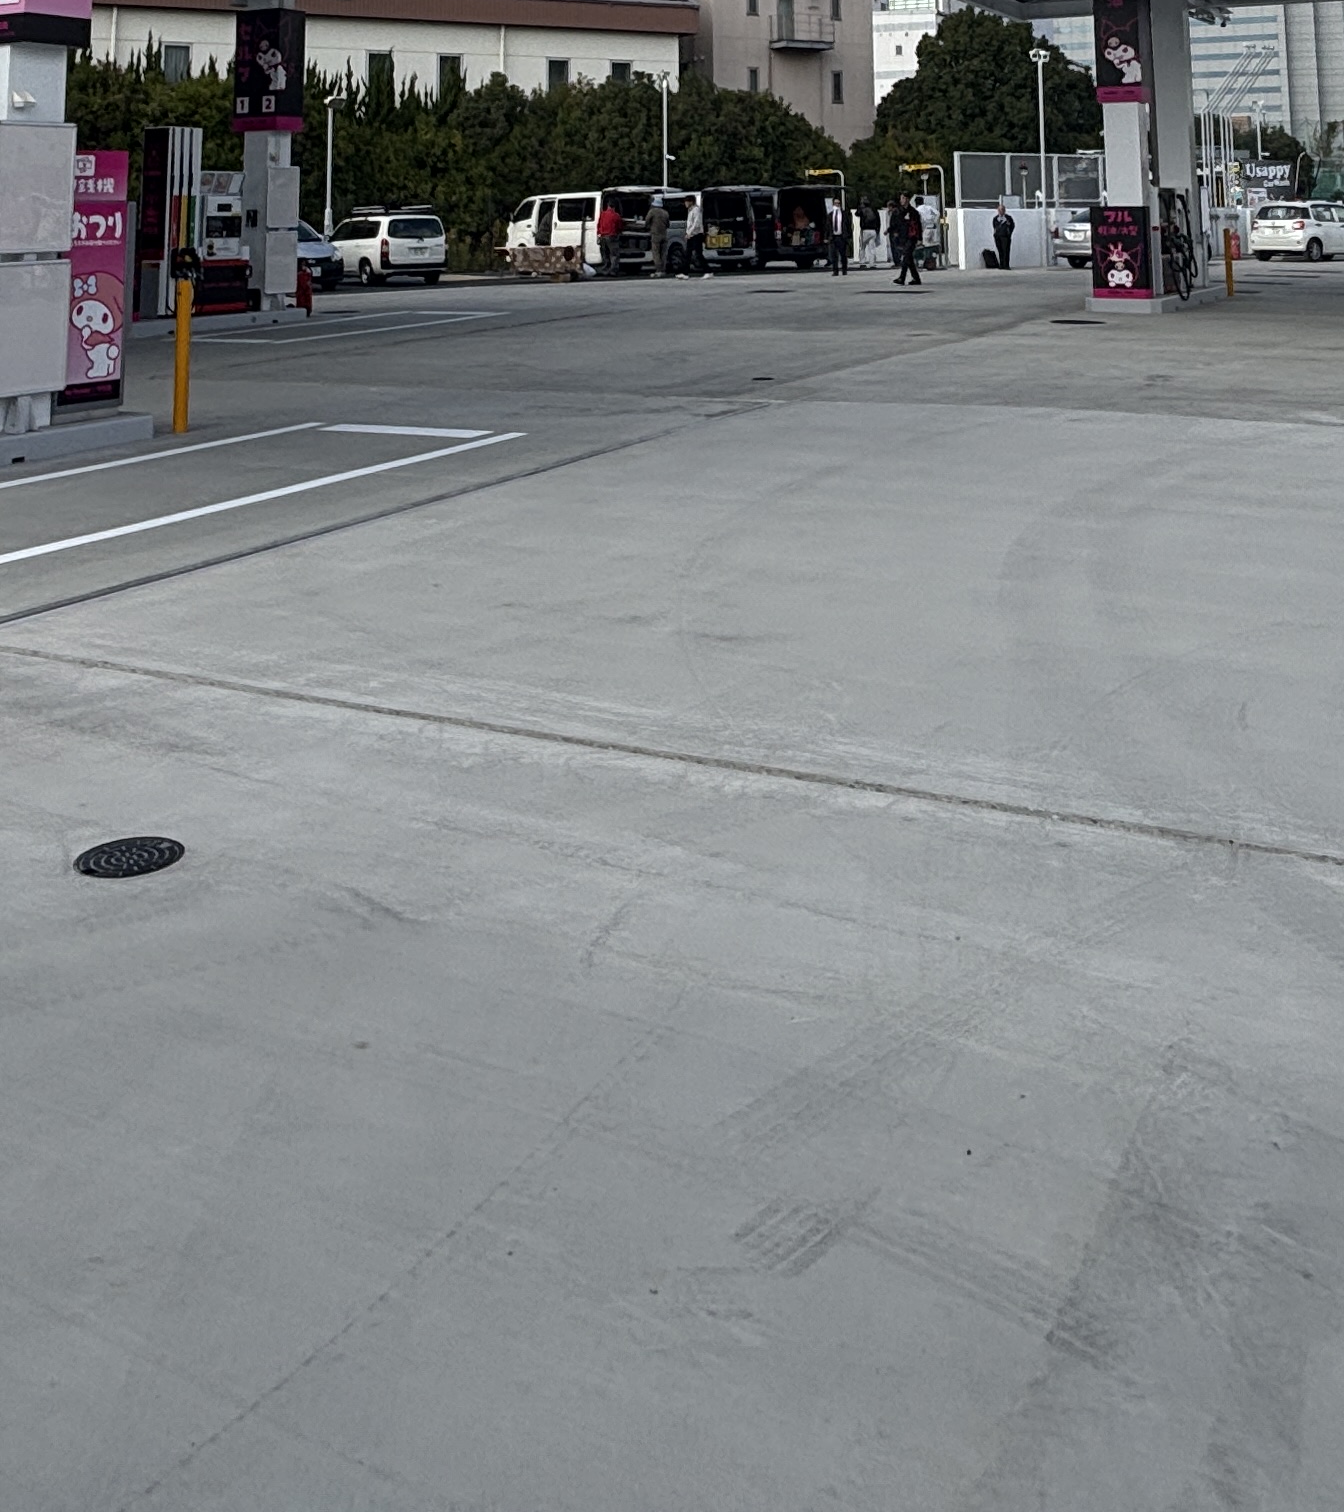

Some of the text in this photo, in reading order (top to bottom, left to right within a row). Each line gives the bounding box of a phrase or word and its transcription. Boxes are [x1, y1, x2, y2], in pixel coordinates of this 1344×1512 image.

[1245, 163, 1291, 180] Usappy
[71, 211, 123, 240] おつり
[1103, 211, 1133, 223] フル
